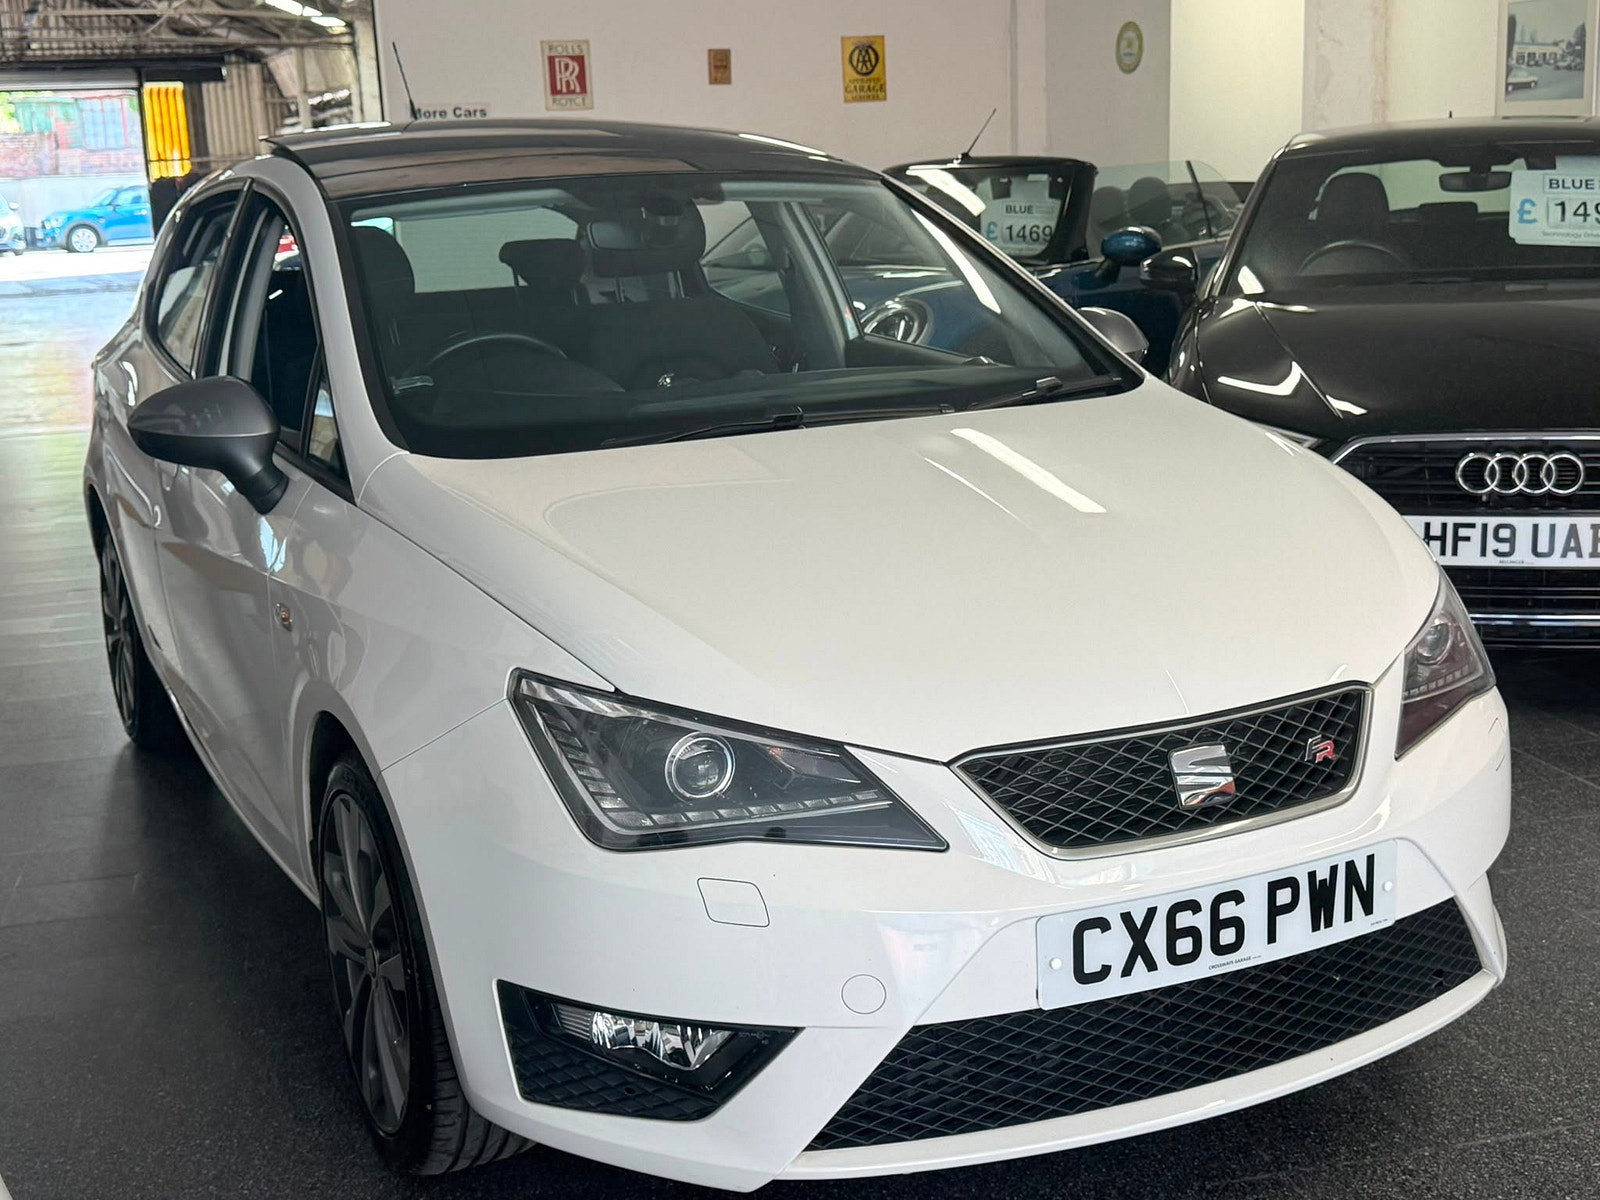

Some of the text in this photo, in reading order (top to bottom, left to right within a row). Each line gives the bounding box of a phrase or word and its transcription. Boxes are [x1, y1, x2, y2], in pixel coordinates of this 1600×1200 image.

[548, 44, 584, 54] ROLLS
[453, 106, 487, 118] Cars
[1549, 178, 1595, 190] BLUE
[1005, 204, 1034, 214] BLUE
[1517, 198, 1538, 225] £
[986, 221, 1053, 242] £ 1469
[1423, 521, 1518, 558] HF19
[1072, 853, 1375, 985] CX66 PWN
